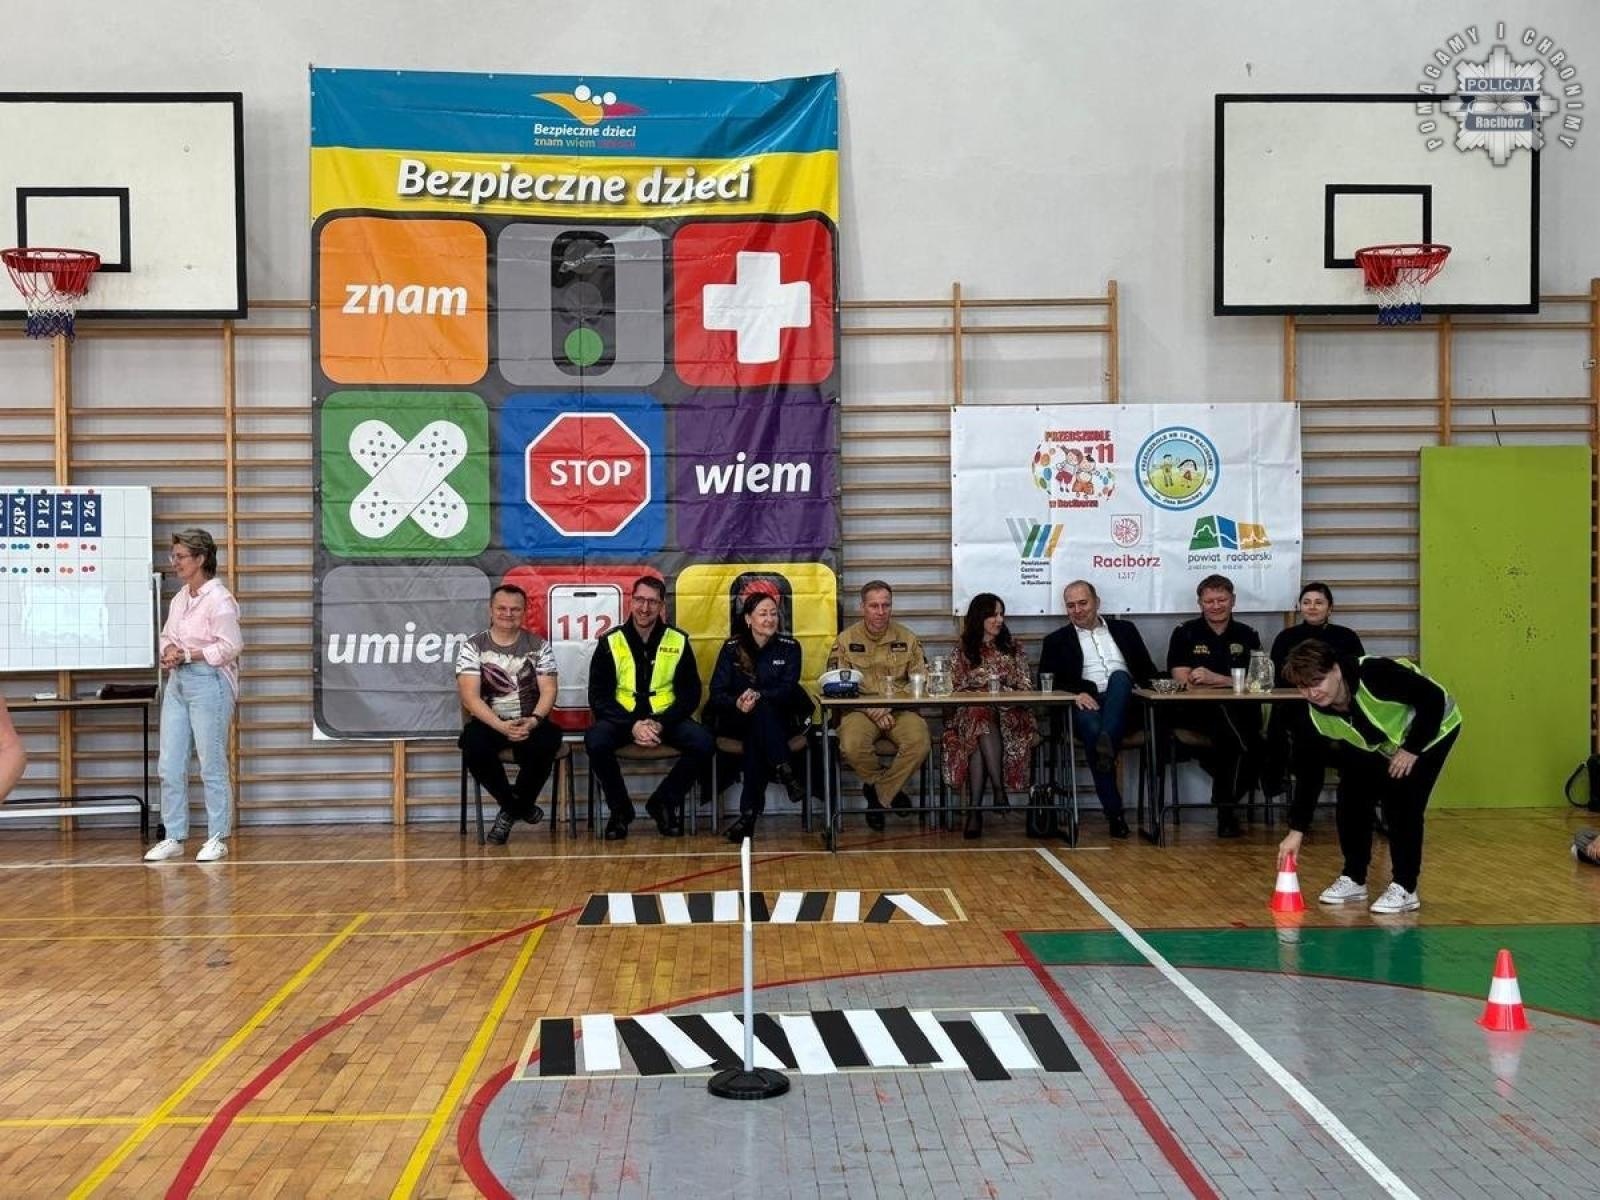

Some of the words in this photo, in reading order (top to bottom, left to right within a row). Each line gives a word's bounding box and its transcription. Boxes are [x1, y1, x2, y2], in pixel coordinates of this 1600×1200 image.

[534, 123, 600, 138] Bezpieczne
[602, 125, 637, 137] dzieci
[534, 138, 563, 147] znam
[566, 137, 596, 148] wiem
[396, 159, 626, 206] Bezpieczne
[636, 163, 751, 206] dzieci
[343, 283, 468, 316] znam
[1095, 443, 1114, 463] 11
[550, 460, 632, 487] STOP
[696, 453, 811, 494] wiem
[14, 496, 26, 506] 4
[37, 499, 49, 515] 12
[61, 500, 73, 516] 14
[84, 500, 96, 517] 26
[13, 508, 26, 535] ZSP
[37, 519, 49, 529] P
[60, 520, 73, 530] P
[84, 522, 96, 532] P
[1093, 554, 1160, 568] Racibórz
[1188, 554, 1220, 563] powiat
[1226, 551, 1272, 561] raciborski
[557, 615, 612, 641] 112
